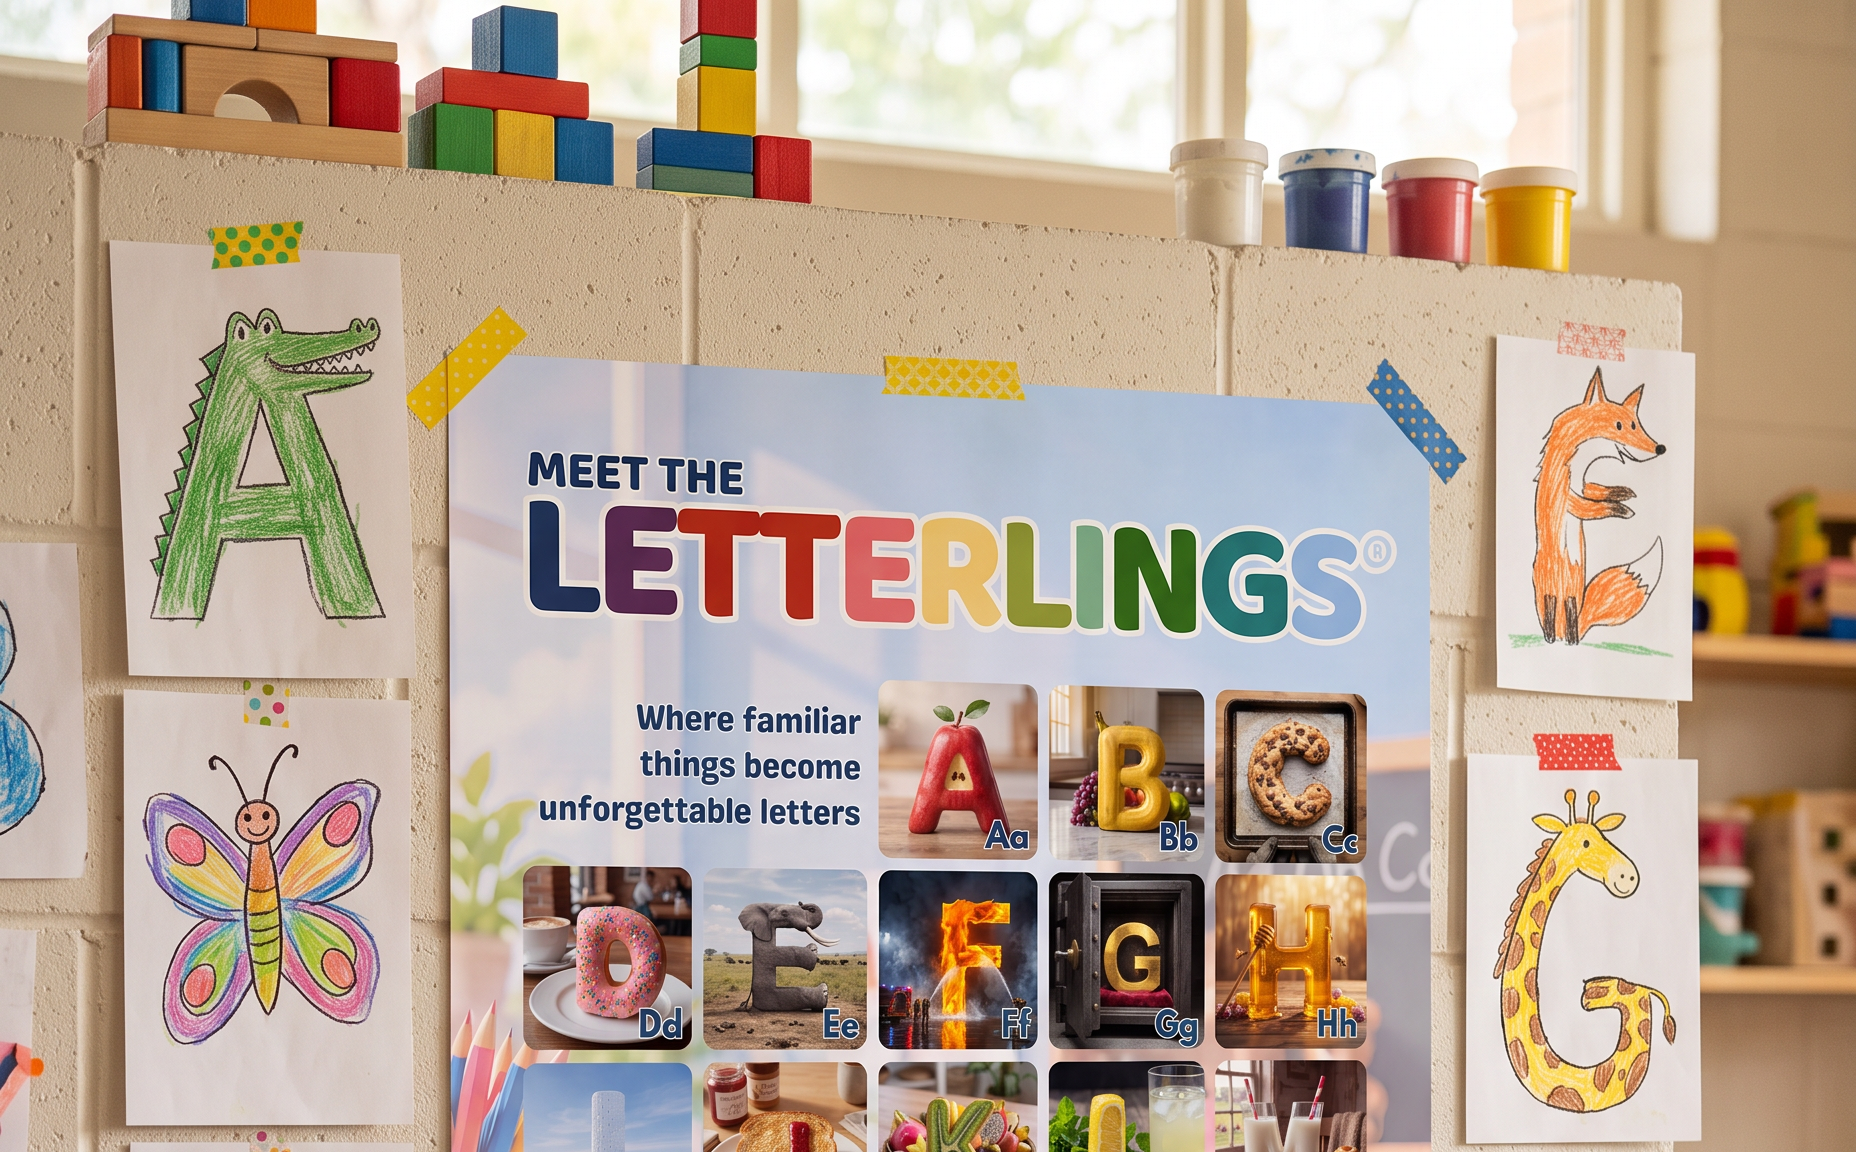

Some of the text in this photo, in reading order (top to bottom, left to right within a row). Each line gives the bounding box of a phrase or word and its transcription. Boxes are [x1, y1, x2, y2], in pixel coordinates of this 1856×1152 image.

[527, 450, 744, 496] MEET THE
[636, 703, 862, 735] Where familiar
[640, 749, 861, 786] things become
[539, 795, 861, 830] unforgettable letters
[984, 820, 1030, 851] Aa
[1159, 821, 1198, 853] Bb
[1322, 824, 1359, 854] Cc
[638, 1007, 683, 1040] Dd
[822, 1008, 860, 1039] Ee
[1001, 1007, 1032, 1040] Ff
[1154, 1008, 1198, 1047] Gg
[1317, 1008, 1358, 1038] Hh
